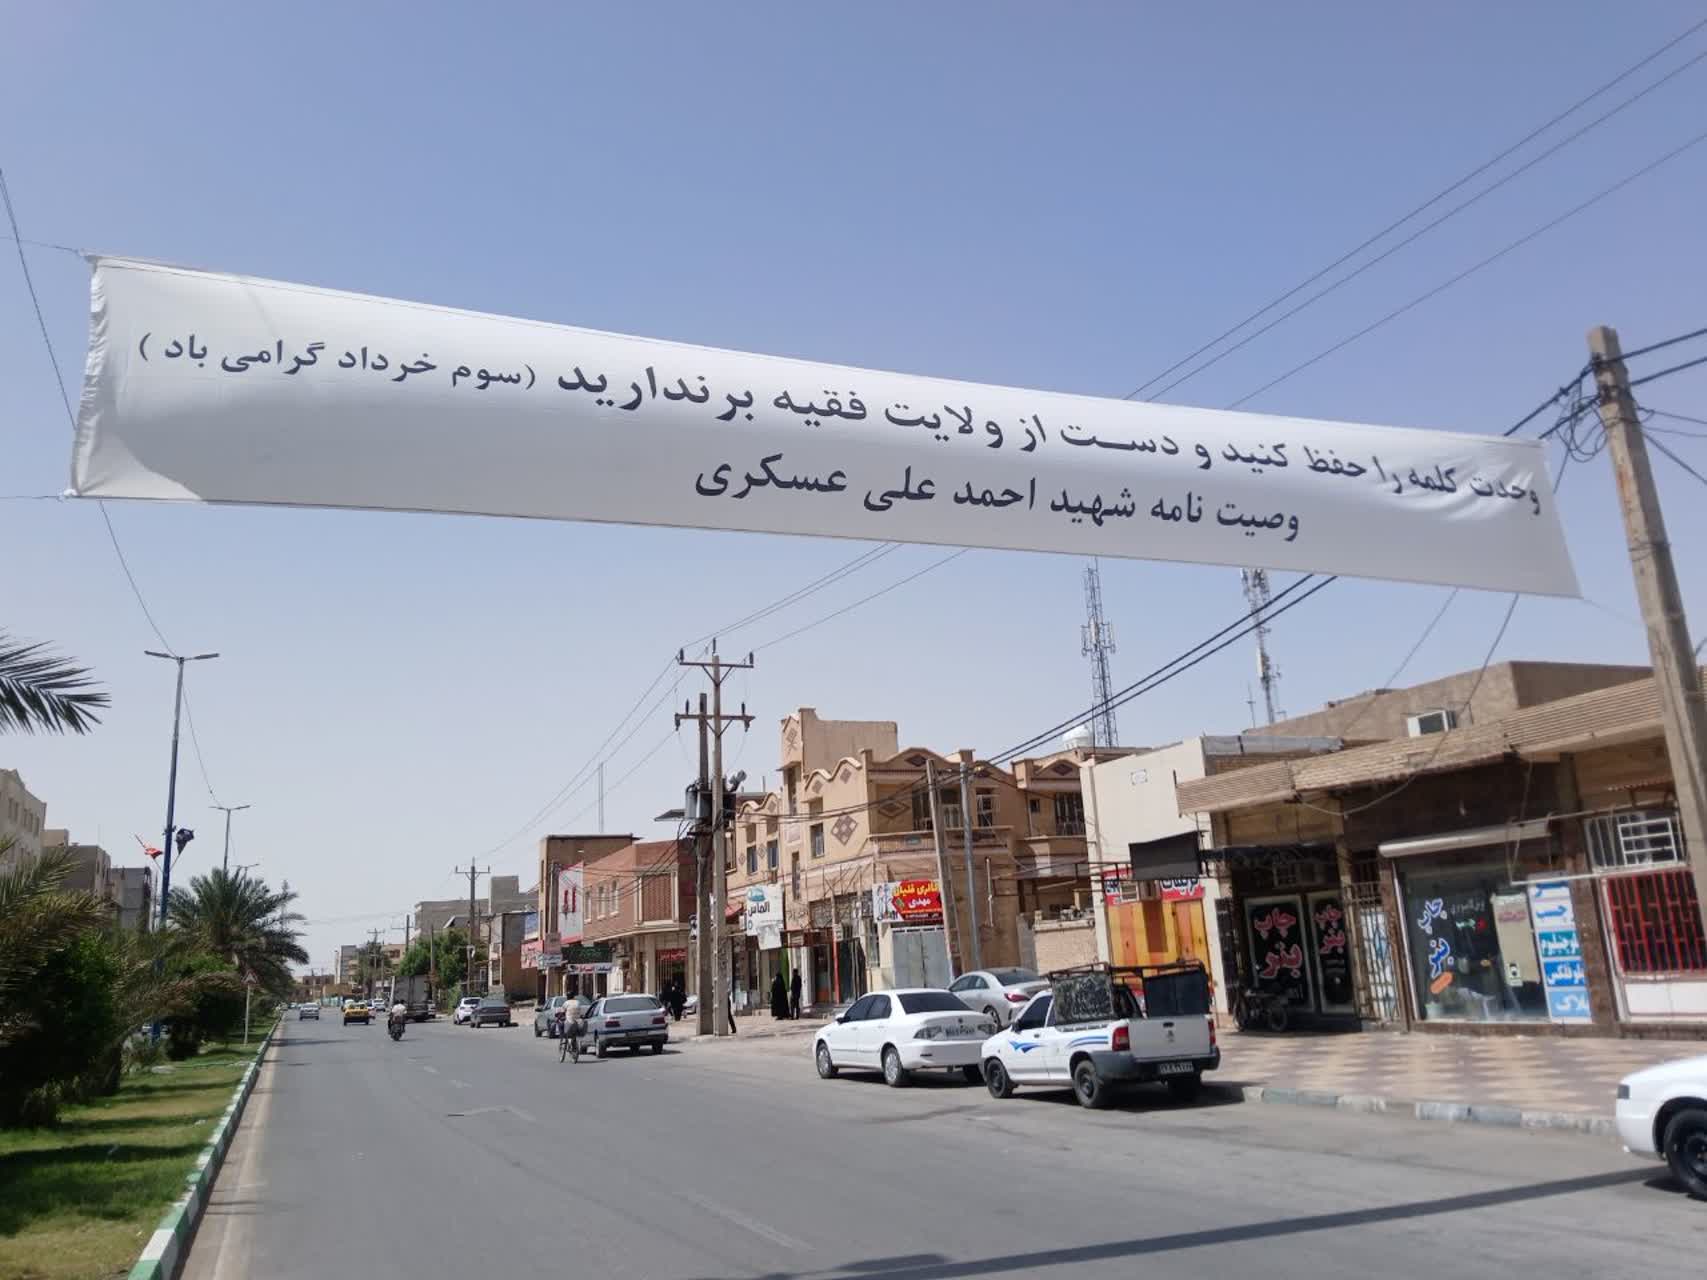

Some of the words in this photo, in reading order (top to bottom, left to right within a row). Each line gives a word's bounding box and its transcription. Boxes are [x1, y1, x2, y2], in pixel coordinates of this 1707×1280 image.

[220, 338, 326, 376] گرامی
[338, 346, 438, 383] خرداد
[773, 388, 868, 428] فقیه
[885, 403, 1004, 449] ولایت
[1020, 413, 1047, 453] از
[1060, 424, 1180, 456] دست
[695, 452, 847, 500] عسکری
[1195, 443, 1212, 471] و
[1222, 442, 1288, 474] کنید
[1303, 445, 1367, 478] حفظ
[1371, 455, 1403, 495] را
[863, 465, 936, 512] علی
[953, 477, 1037, 511] احمد
[1408, 464, 1457, 494] کلمه
[1470, 477, 1541, 516] وحدت
[1049, 487, 1136, 528] شهید
[1150, 491, 1203, 524] نامه
[1216, 503, 1299, 542] وصیت
[1254, 907, 1297, 939] چاپ
[1417, 898, 1448, 935] چاپ
[1260, 941, 1303, 979] بنر
